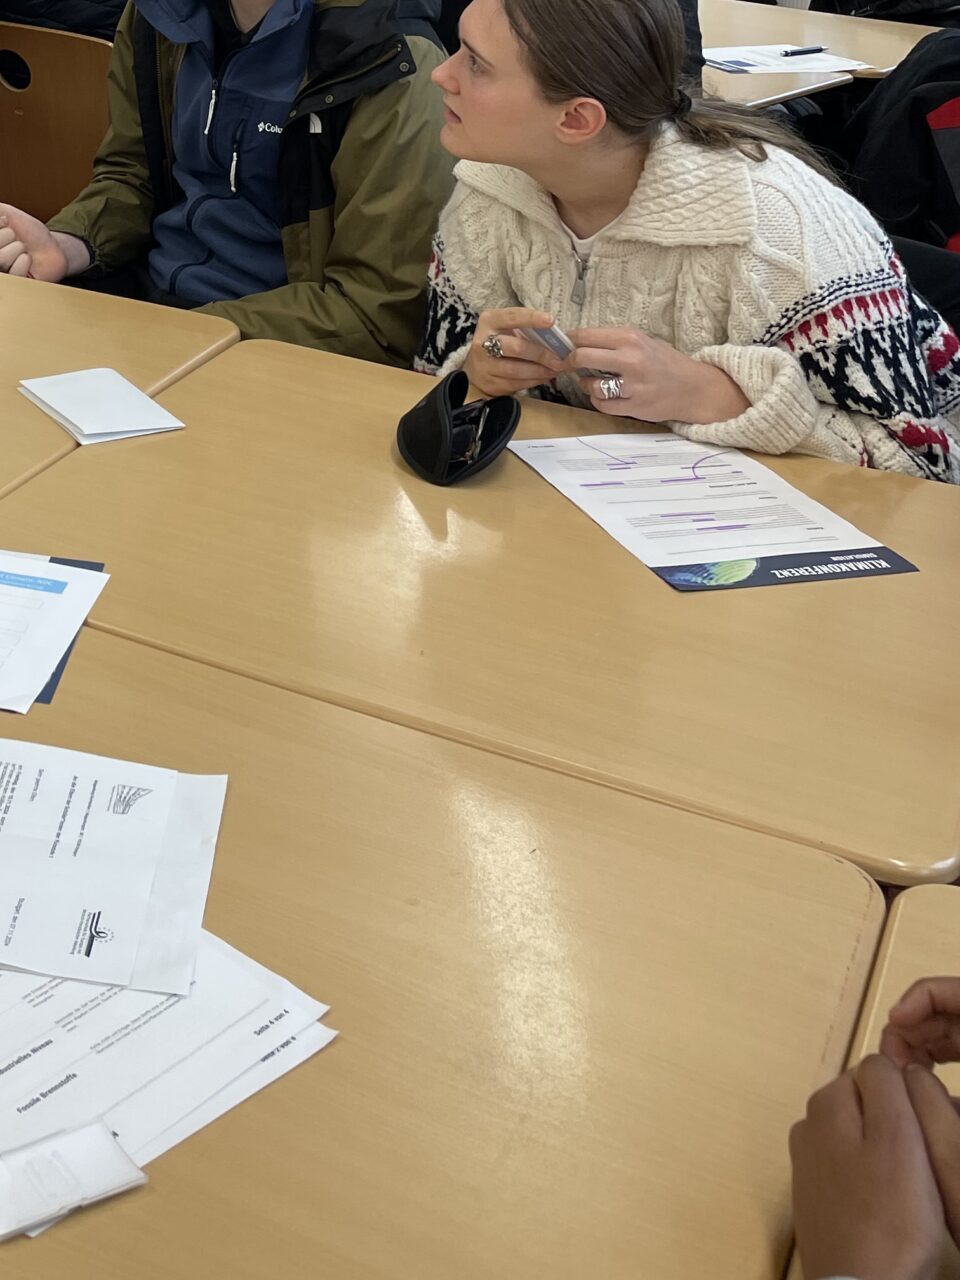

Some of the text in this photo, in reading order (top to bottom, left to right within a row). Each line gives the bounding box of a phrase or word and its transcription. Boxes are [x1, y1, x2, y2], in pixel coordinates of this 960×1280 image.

[770, 558, 892, 580] KLIMAKONFERENZ
[273, 1012, 285, 1021] von
[30, 1038, 54, 1057] Niveau
[16, 1072, 78, 1114] Fossile Brennstoffe
